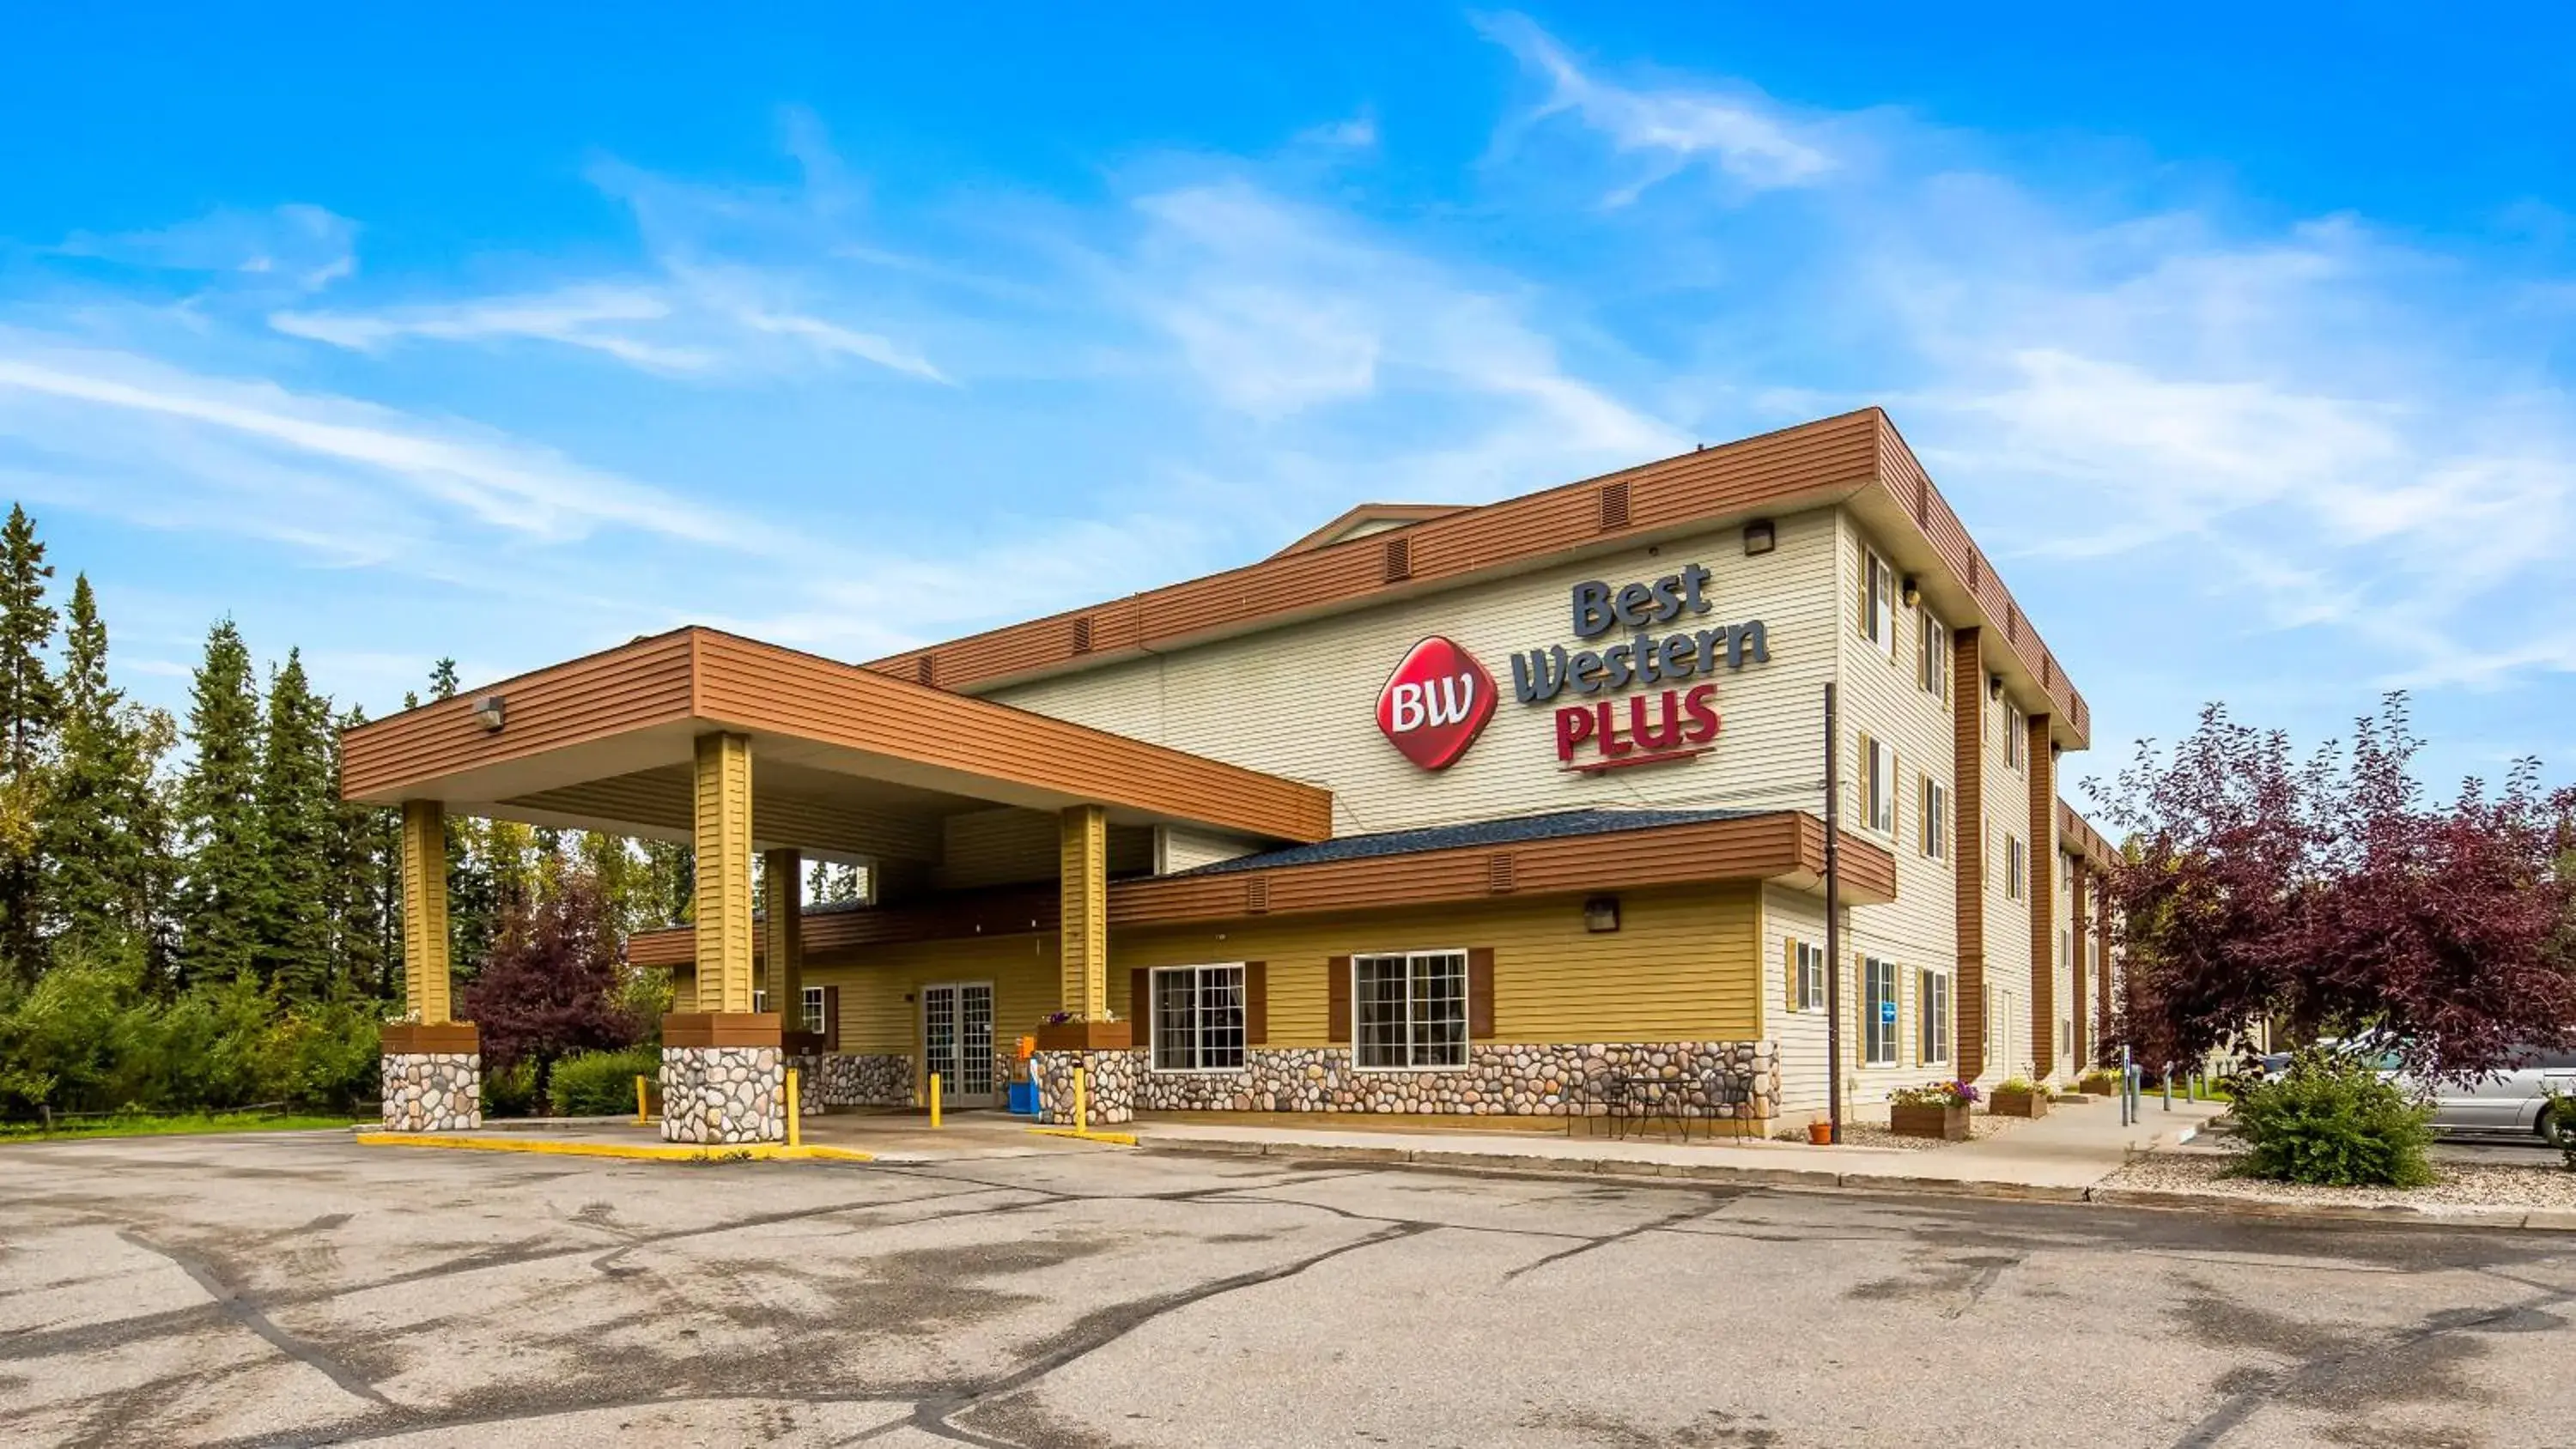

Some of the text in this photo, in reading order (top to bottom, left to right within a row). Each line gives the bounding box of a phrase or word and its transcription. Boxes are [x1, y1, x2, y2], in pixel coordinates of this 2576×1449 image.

[1572, 562, 1712, 638] Best
[1510, 619, 1771, 703] Western
[1392, 672, 1473, 732] BW
[1555, 683, 1721, 761] PLUS
